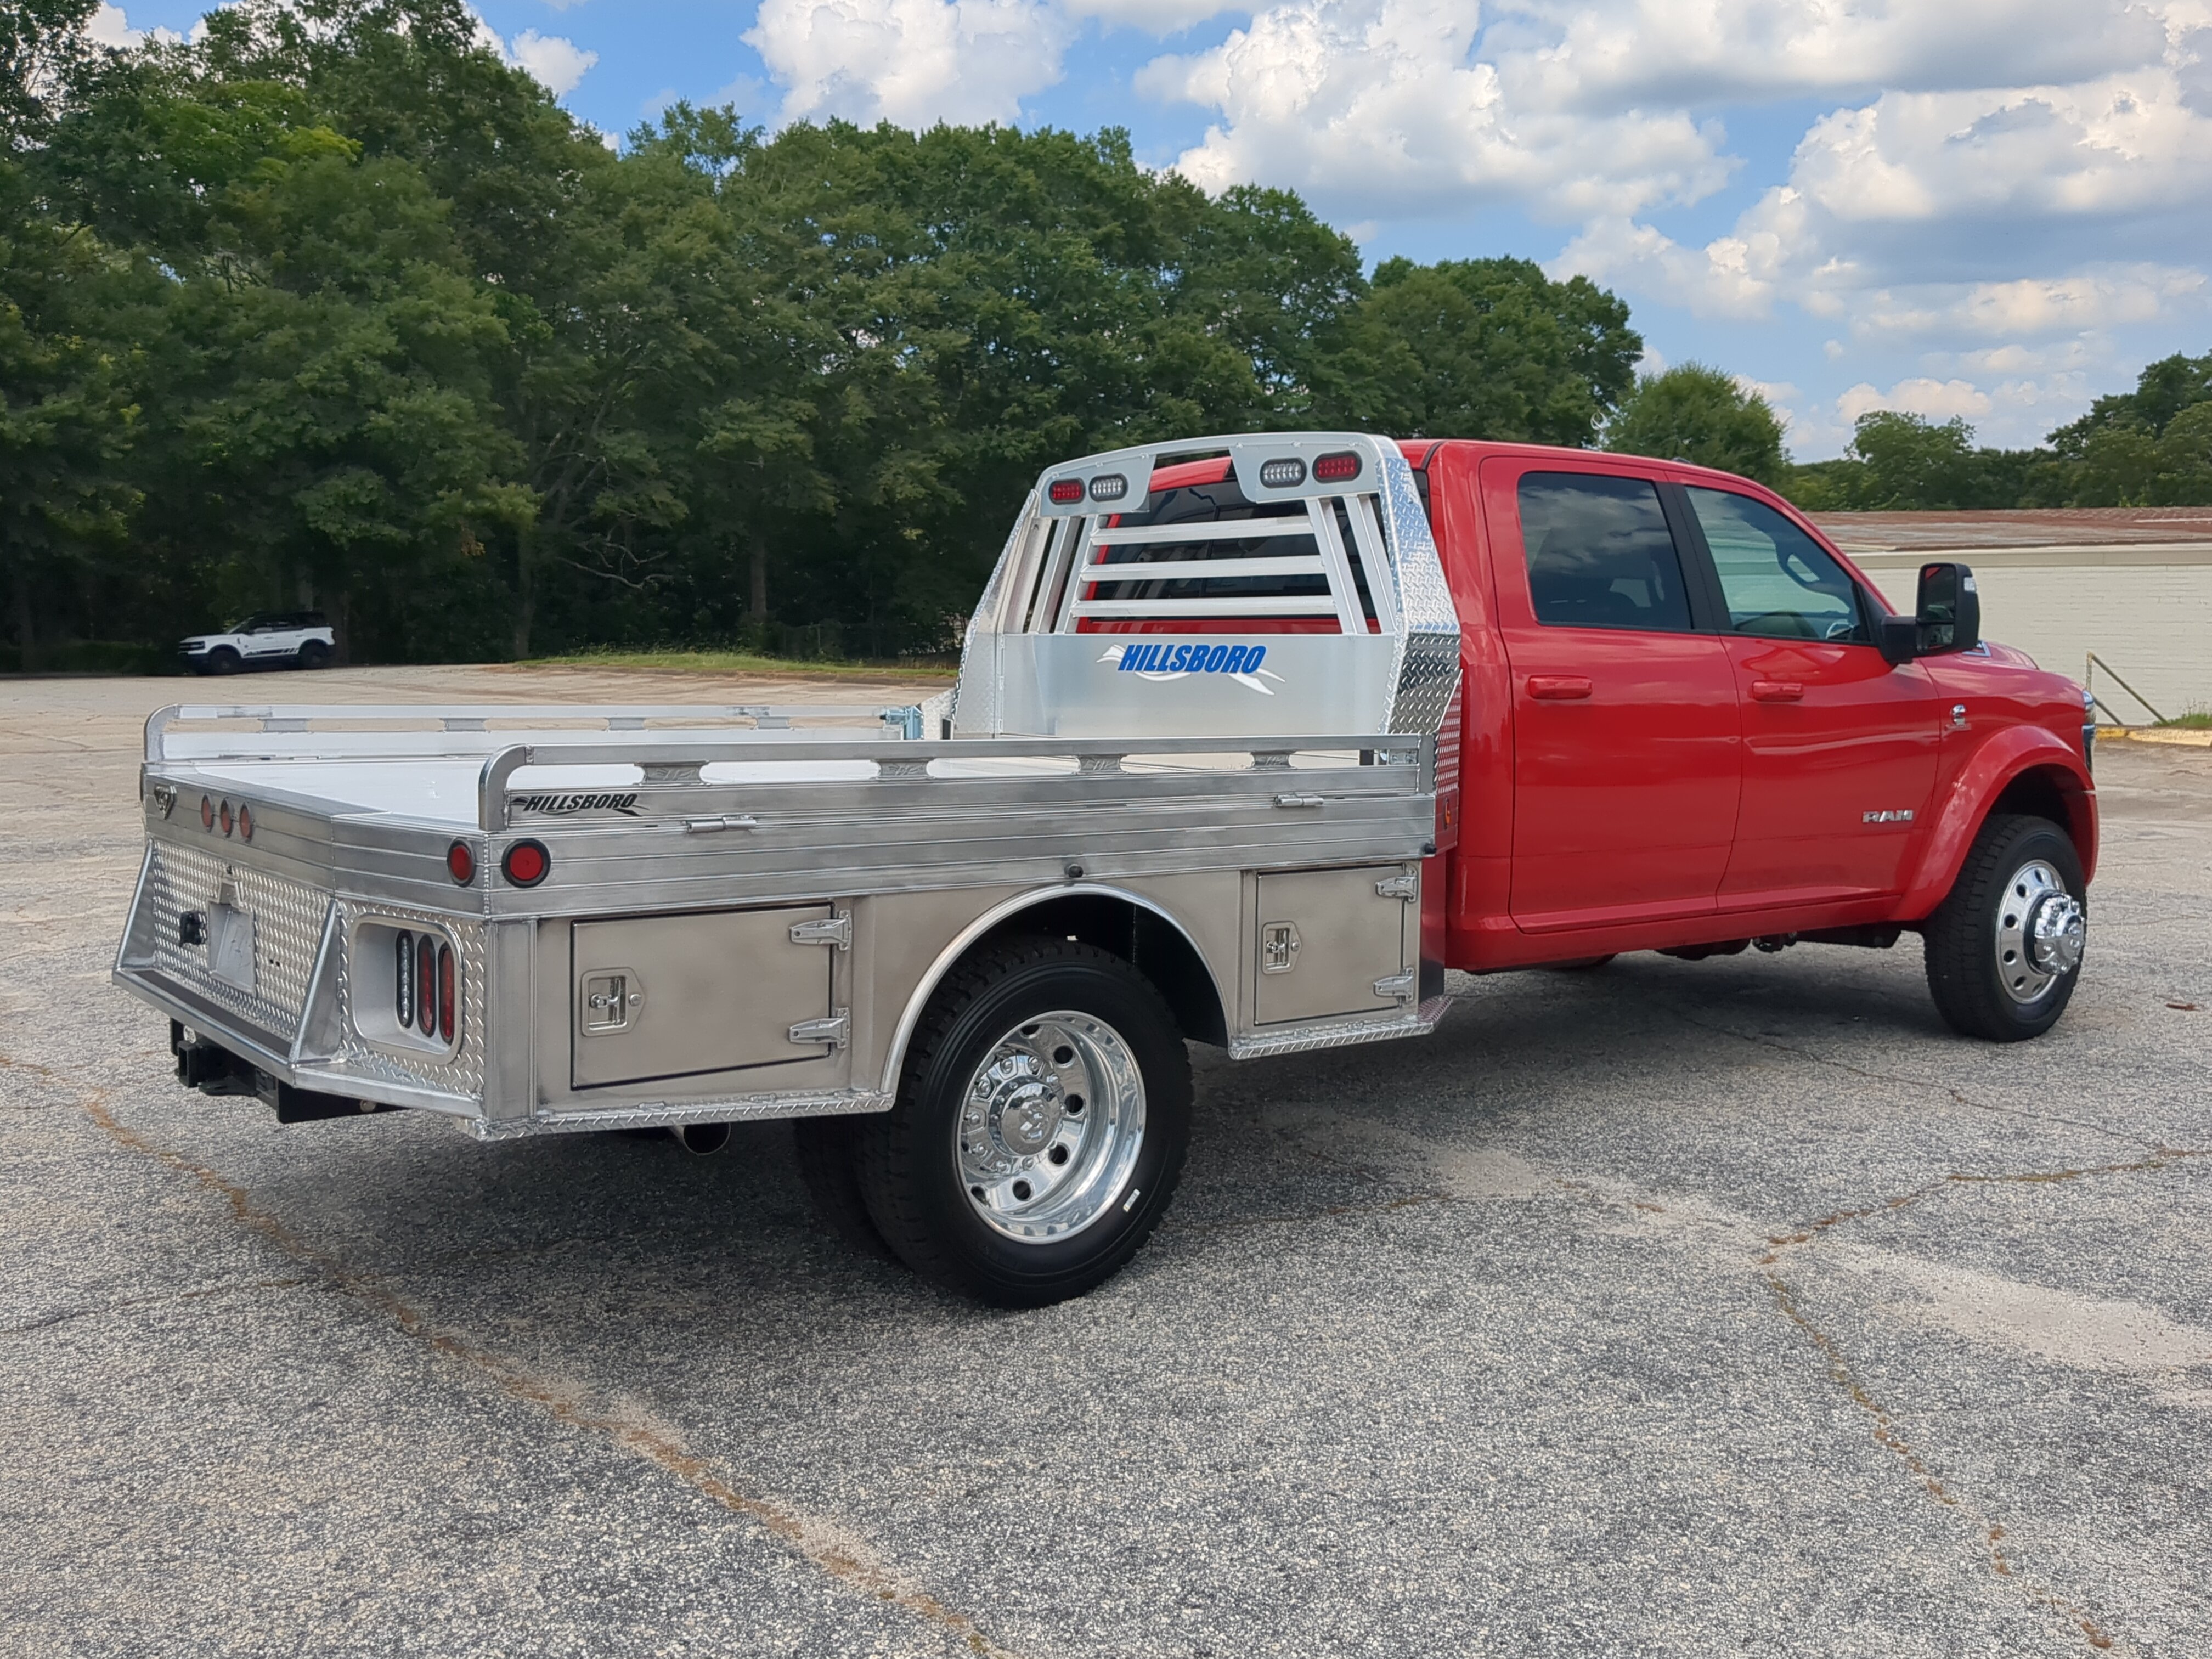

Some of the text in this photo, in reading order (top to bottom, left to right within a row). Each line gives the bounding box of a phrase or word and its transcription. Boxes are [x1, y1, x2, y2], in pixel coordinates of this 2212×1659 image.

[1118, 644, 1267, 674] HILLSBORO
[523, 793, 637, 811] HILLSBORO
[1863, 810, 1913, 823] RAM
